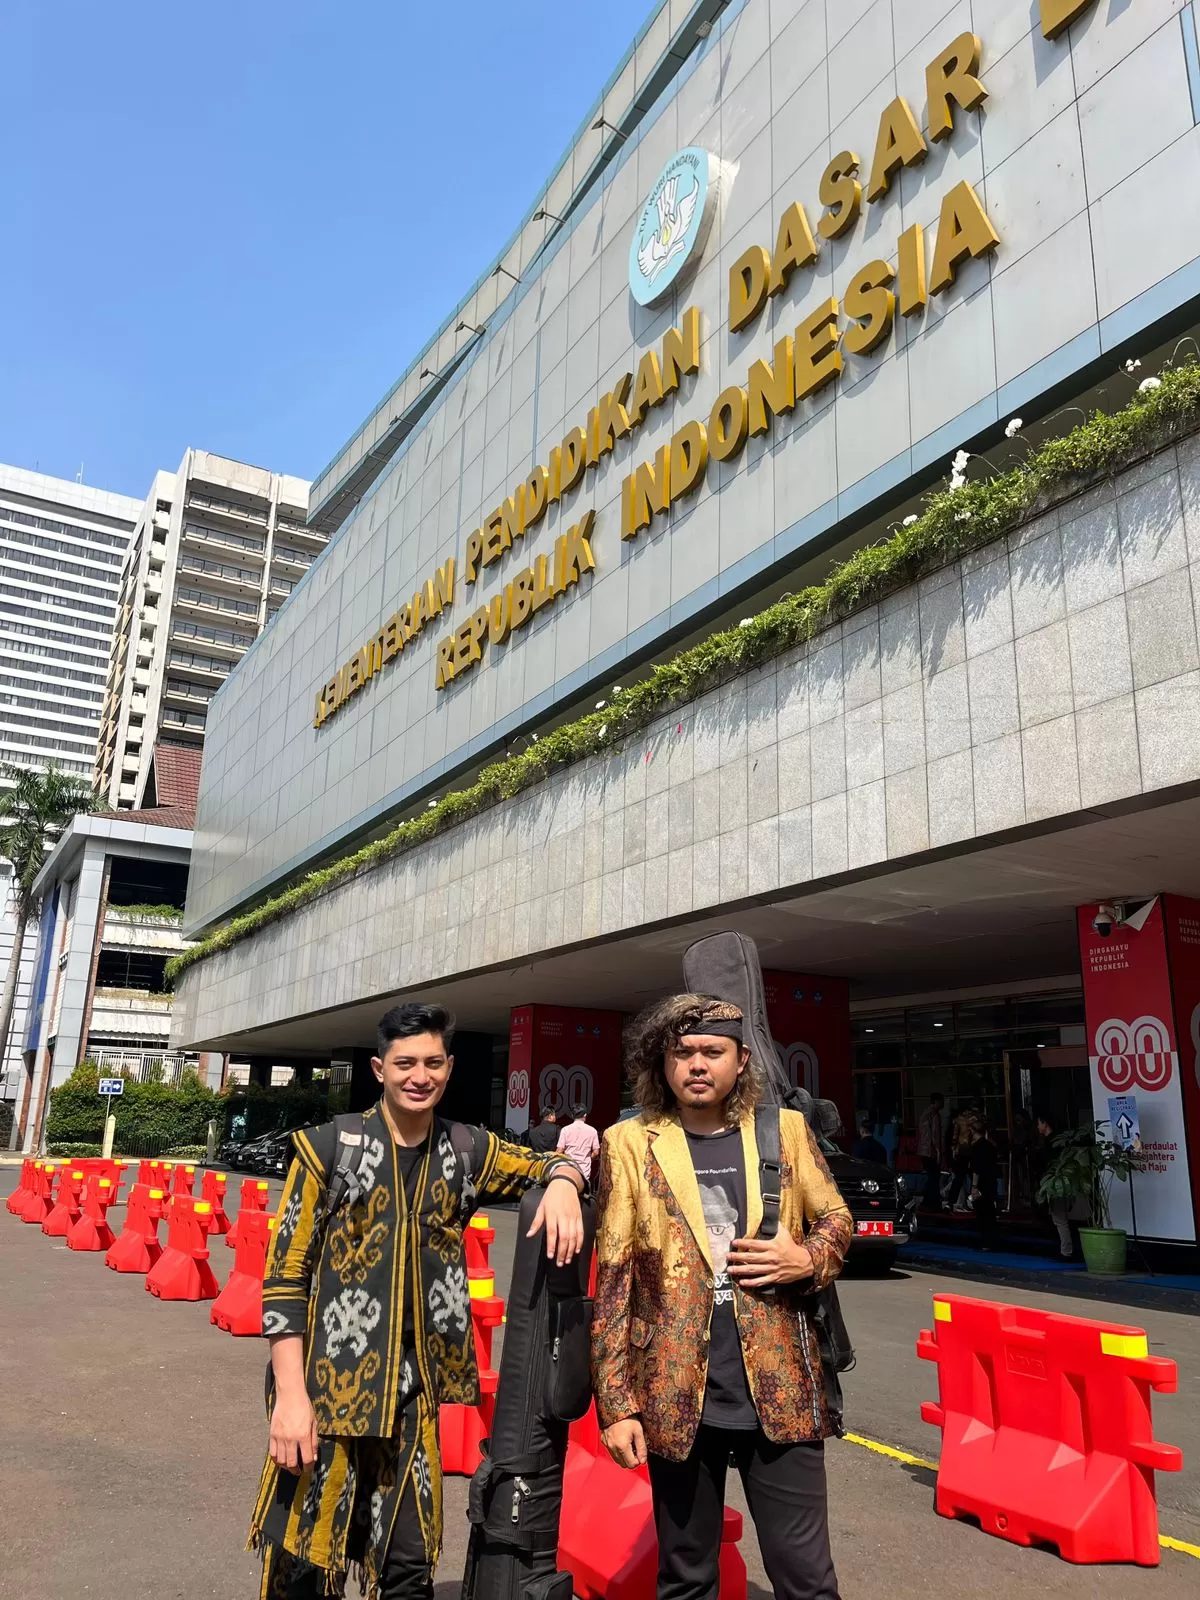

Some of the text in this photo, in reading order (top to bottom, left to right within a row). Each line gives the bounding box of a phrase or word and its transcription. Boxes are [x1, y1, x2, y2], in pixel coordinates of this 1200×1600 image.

[313, 31, 990, 729] KEMENTERIAN PENDIDIKAN DASAR
[434, 179, 1001, 691] REPUBLIK INDONESIA
[1089, 944, 1129, 956] DIRGAHAYU
[1090, 953, 1125, 964] REPUBLIK
[1091, 961, 1129, 972] INDONESIA
[1095, 1015, 1173, 1093] 80
[509, 1069, 529, 1109] 80
[539, 1063, 594, 1118] 80
[1148, 1163, 1167, 1173] Maju
